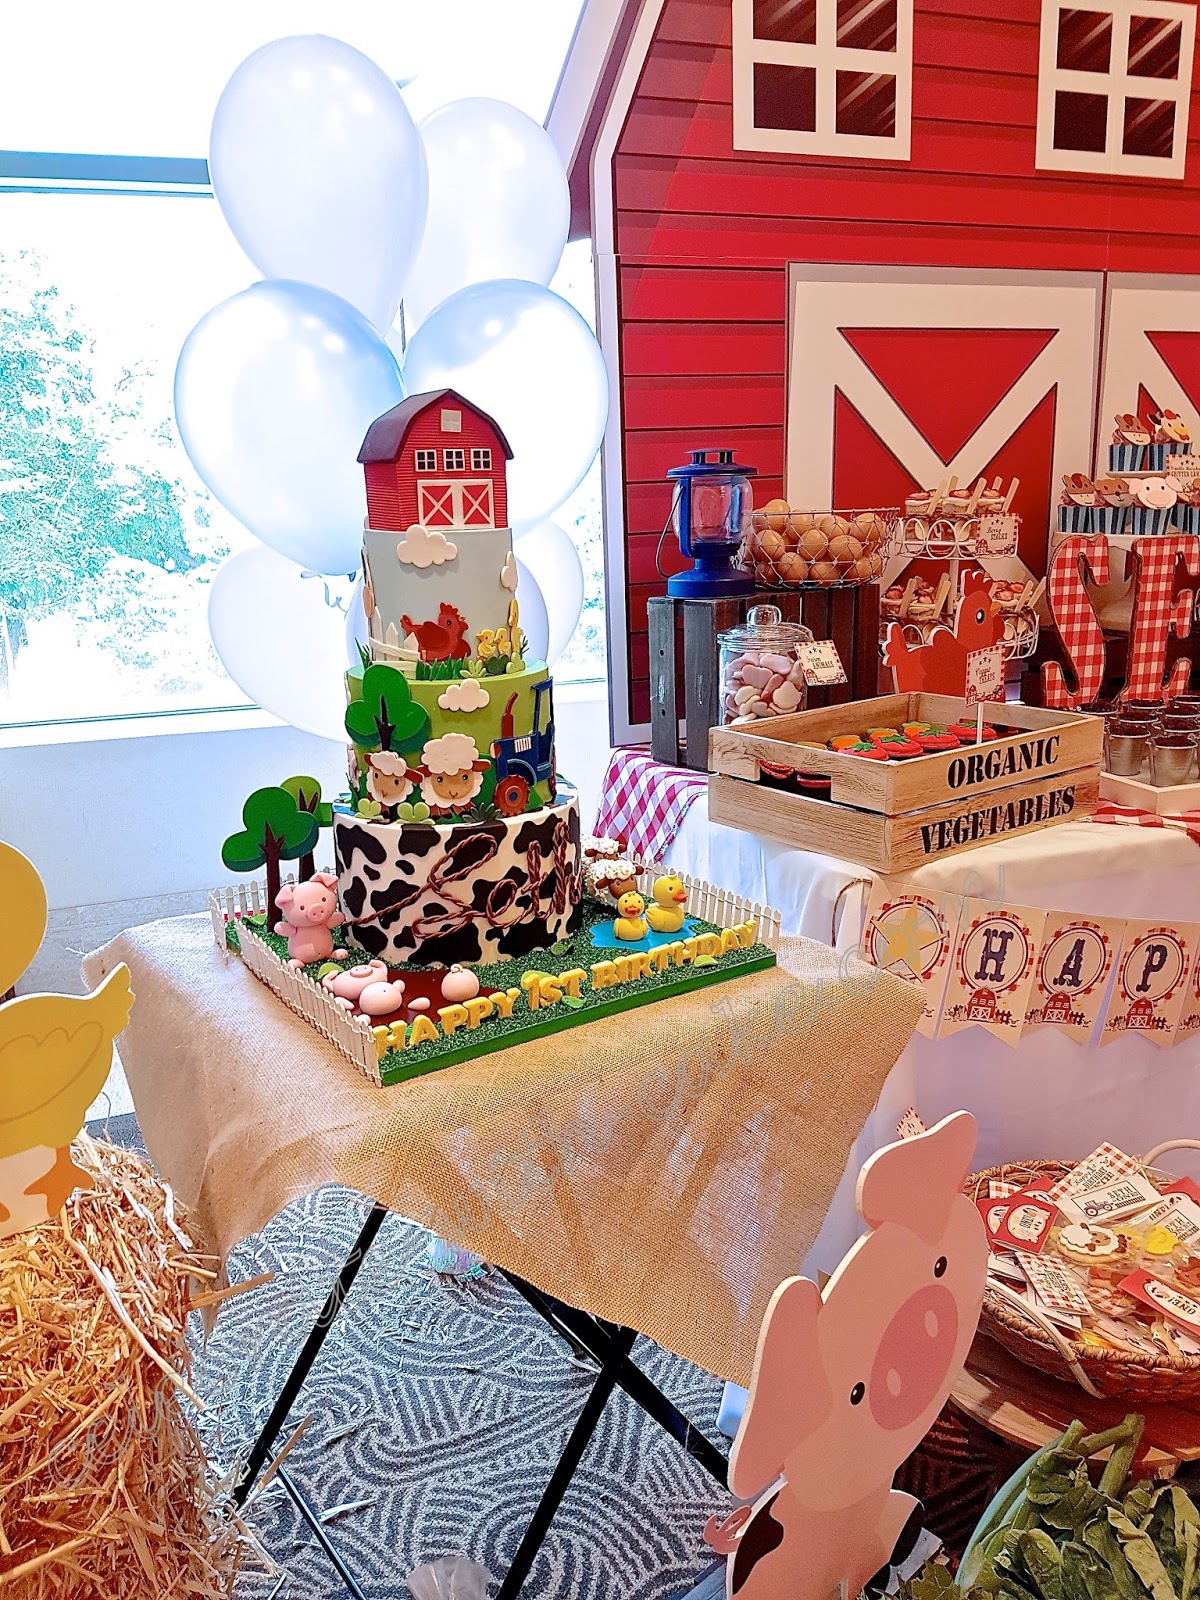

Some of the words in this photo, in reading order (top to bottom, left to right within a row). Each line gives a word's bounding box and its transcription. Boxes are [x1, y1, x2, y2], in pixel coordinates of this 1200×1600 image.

[946, 735, 1060, 789] ORGANIC
[919, 785, 1076, 854] VEGETABLES
[372, 987, 521, 1060] HAPPY
[522, 968, 588, 1011] 1ST
[590, 919, 758, 991] BIRTHDAY
[1082, 1166, 1108, 1189] BIRTHDAY
[1107, 1186, 1134, 1201] SETH
[1165, 1216, 1185, 1233] ETH
[1167, 1298, 1197, 1315] ONE!
